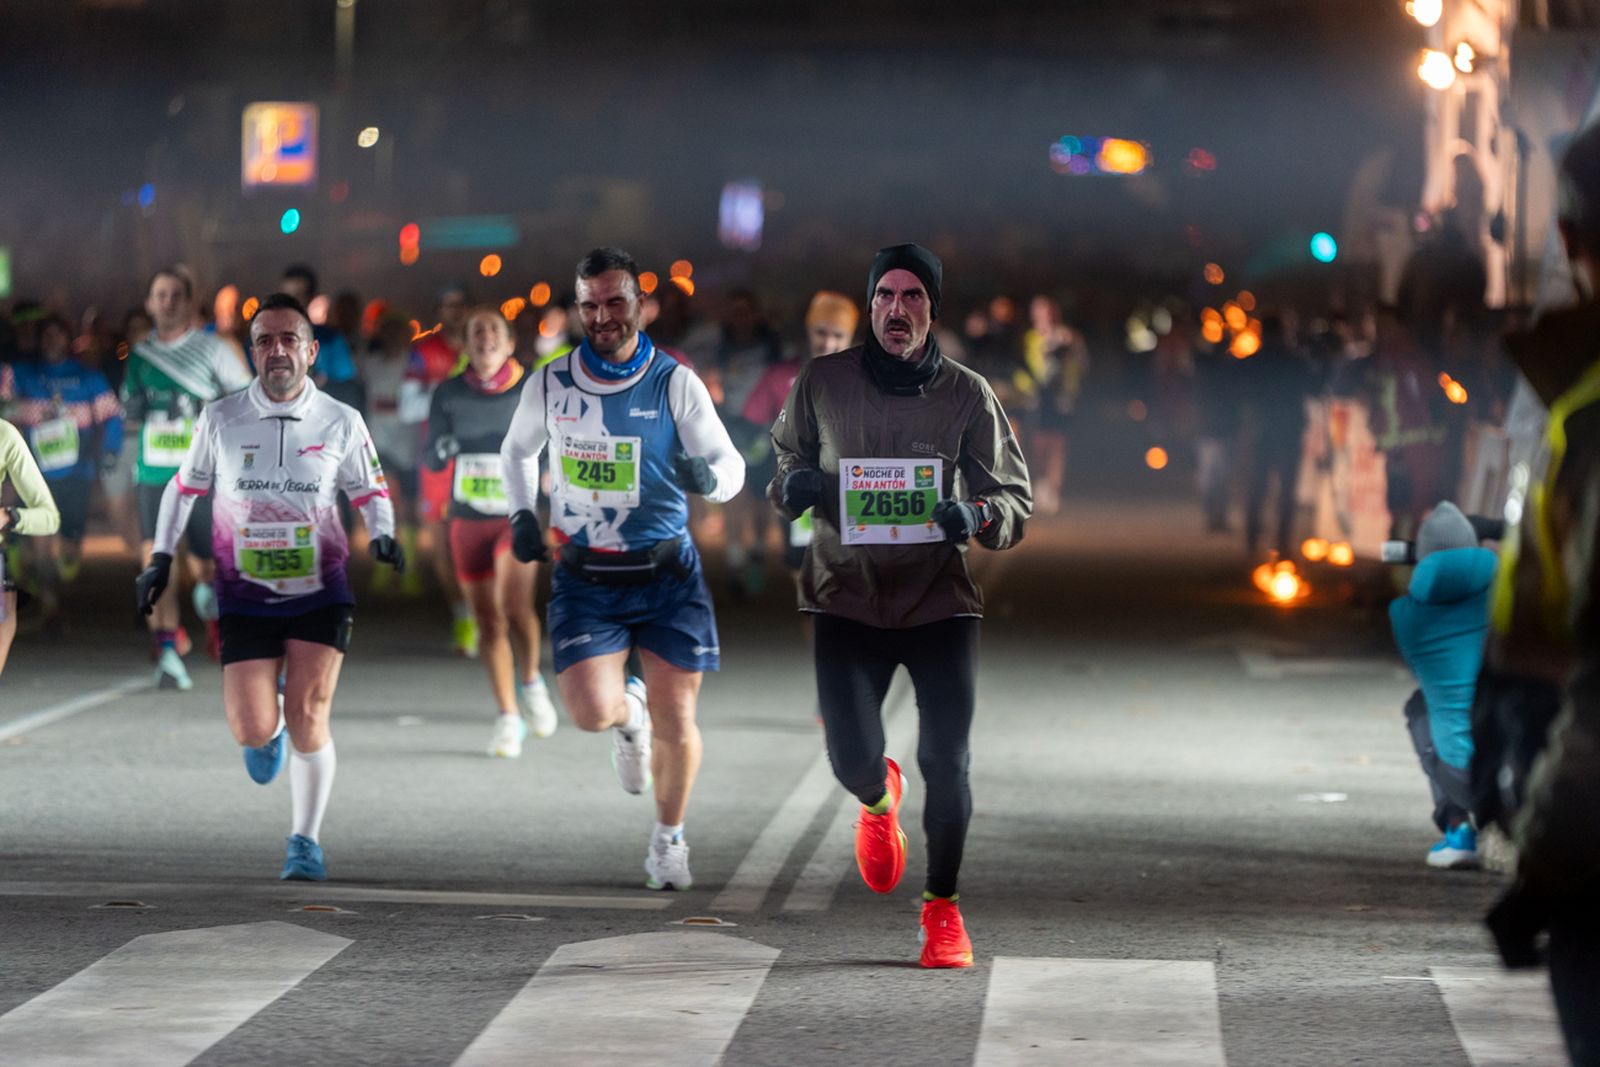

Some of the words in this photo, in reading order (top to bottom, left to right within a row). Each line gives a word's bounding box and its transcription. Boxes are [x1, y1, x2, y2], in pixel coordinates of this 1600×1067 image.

[573, 443, 597, 451] NOCHE
[912, 442, 935, 451] GORE
[565, 449, 579, 458] SAN
[576, 461, 616, 483] 245
[863, 470, 892, 478] NOCHE
[894, 470, 905, 478] DE
[851, 480, 871, 489] SAN
[873, 479, 906, 489] ANTÓN
[860, 491, 926, 516] 2656
[255, 549, 301, 571] 7155
